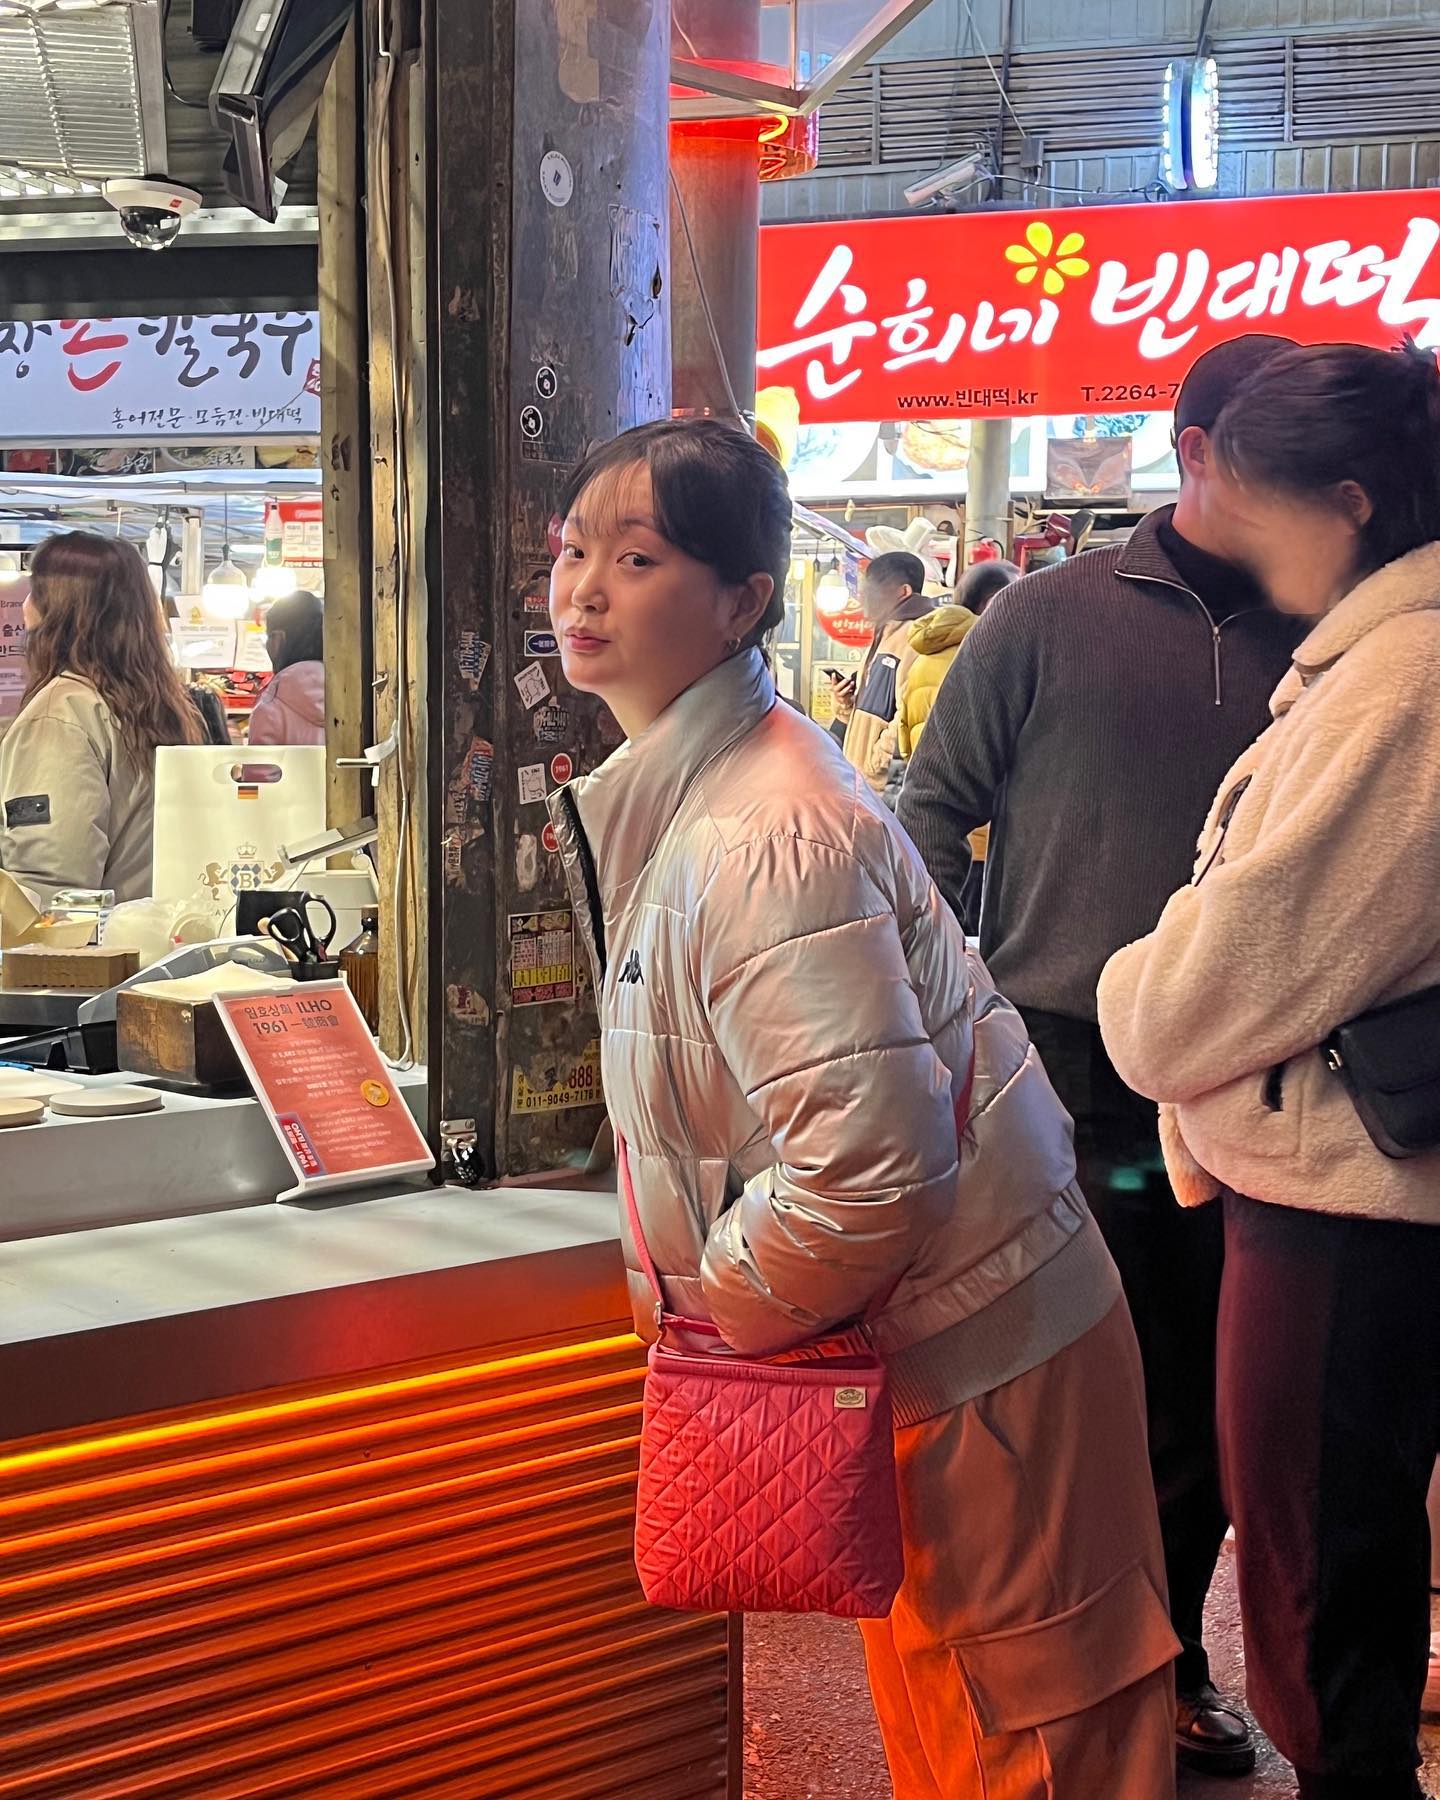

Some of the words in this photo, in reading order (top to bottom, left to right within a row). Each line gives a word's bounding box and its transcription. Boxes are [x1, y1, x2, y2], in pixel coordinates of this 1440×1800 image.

[1090, 216, 1440, 360] 빈대떡
[897, 387, 1039, 408] www.빈대떡.kr
[296, 999, 332, 1014] ILHO
[253, 1020, 289, 1035] 1961
